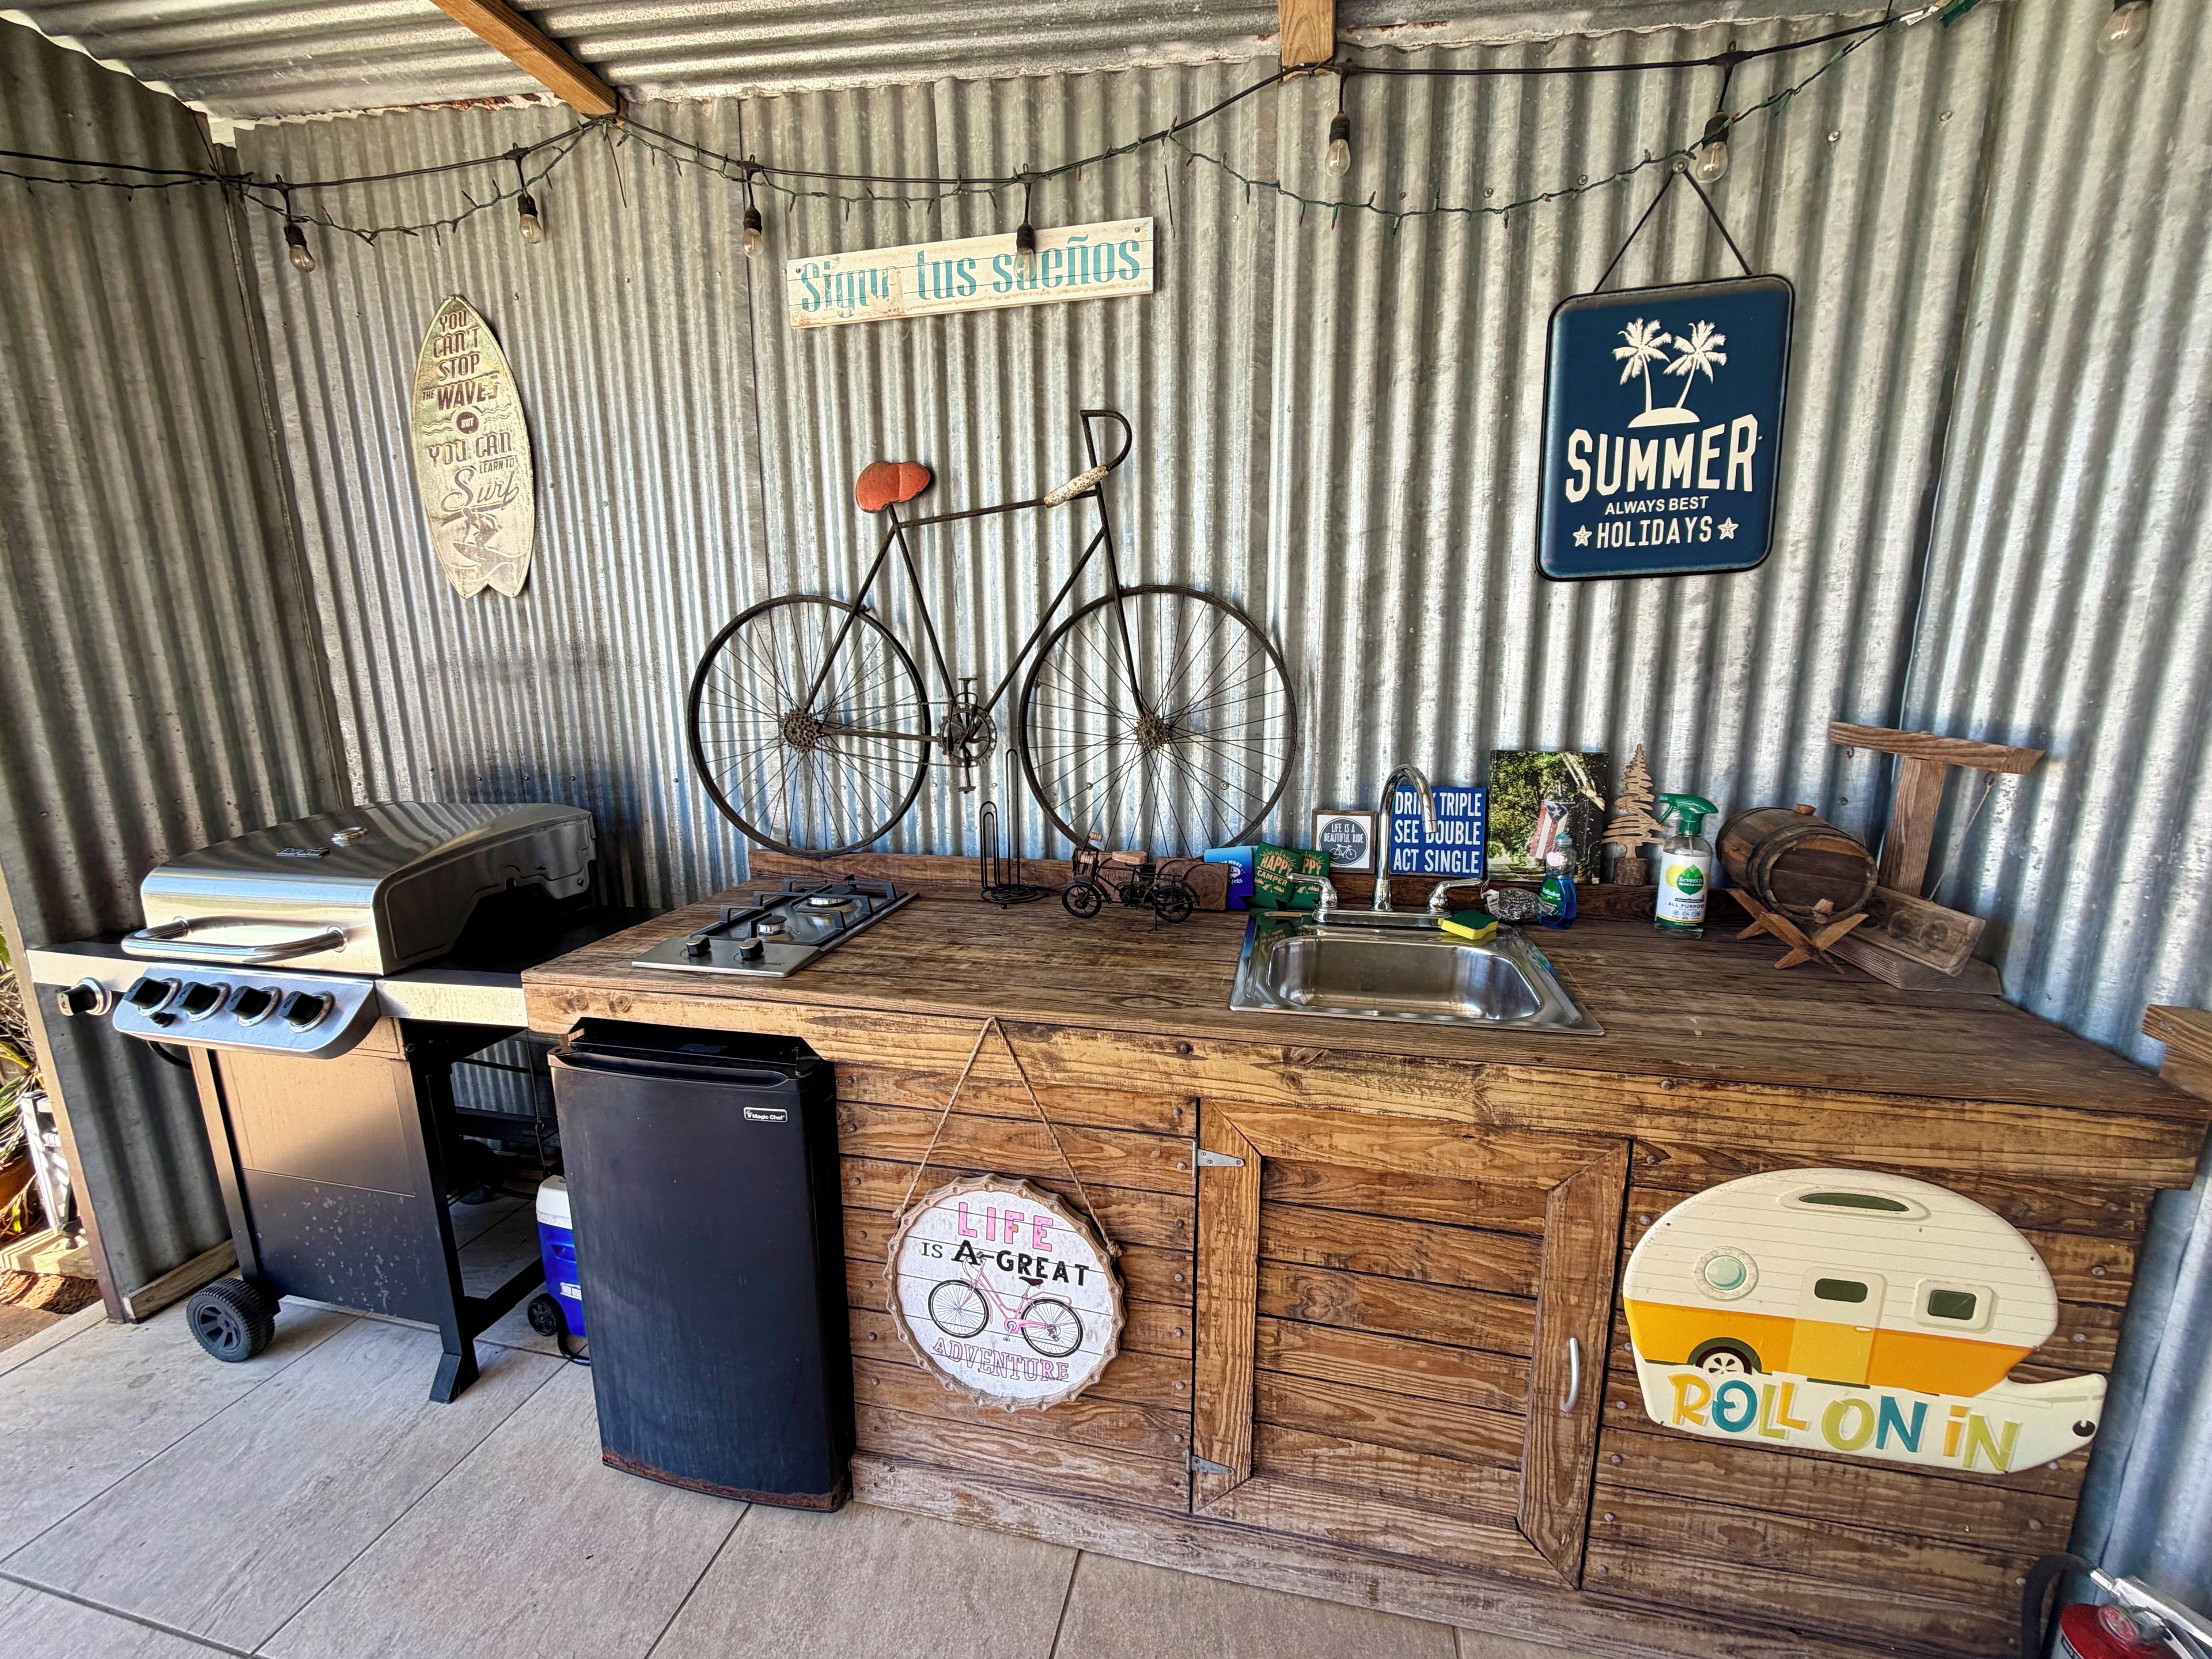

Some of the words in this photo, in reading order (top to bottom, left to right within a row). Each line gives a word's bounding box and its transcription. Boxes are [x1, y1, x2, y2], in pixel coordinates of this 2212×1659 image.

[918, 250, 976, 300] tus
[993, 234, 1140, 293] sueños
[440, 310, 467, 332] YOU
[433, 326, 480, 358] CAN'T
[438, 353, 480, 381] STOP
[423, 389, 435, 400] THE
[438, 375, 498, 411] WAVES
[461, 418, 474, 429] BUT
[428, 440, 467, 467] YOU
[475, 433, 512, 458] CAN
[1566, 414, 1758, 503] SUMMER
[479, 460, 503, 474] LEARN
[505, 457, 514, 468] TO
[441, 467, 518, 512] Surf
[1605, 499, 1665, 515] ALWAYS
[1669, 496, 1709, 511] BEST
[1597, 516, 1712, 548] HOLIDAYS
[1395, 791, 1436, 815] DRI
[1440, 792, 1482, 816] TRIPLE
[1324, 832, 1351, 843] BEAUTIFUL
[1352, 834, 1364, 843] RIDE
[1331, 823, 1342, 833] LIFE
[1344, 824, 1350, 833] IS
[1351, 824, 1355, 833] A
[1394, 819, 1419, 843] SEE
[1228, 859, 1243, 868] MORE
[1260, 855, 1293, 876] HAPPY
[1302, 857, 1321, 875] PPY
[1393, 848, 1419, 871] ACT
[1424, 849, 1480, 873] SINGLE
[1257, 870, 1288, 887] CAMPER
[958, 1202, 1053, 1252] LIFE
[921, 1241, 943, 1259] IS
[951, 1239, 981, 1266] A
[996, 1249, 1090, 1286] GREAT
[933, 1337, 1070, 1381] ADVENTURE
[1668, 1372, 1808, 1440] ROLL
[1821, 1395, 1927, 1453] ON
